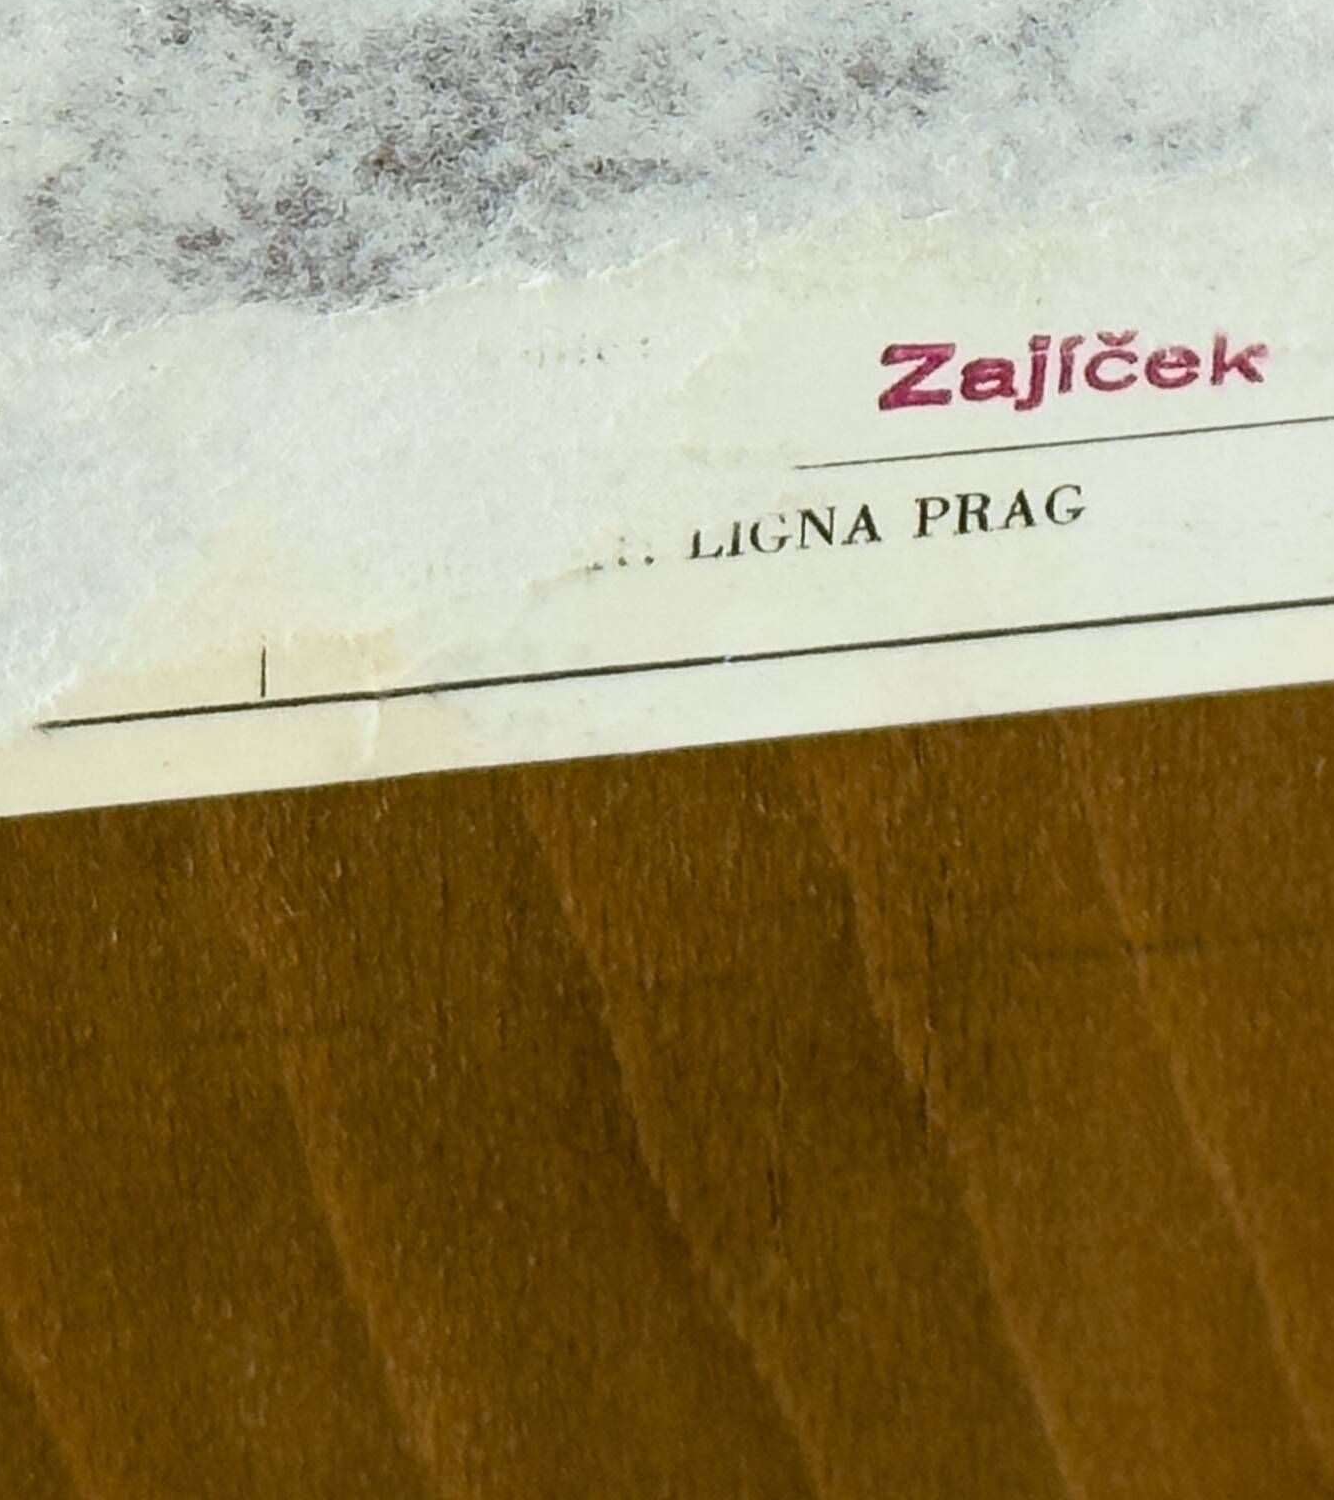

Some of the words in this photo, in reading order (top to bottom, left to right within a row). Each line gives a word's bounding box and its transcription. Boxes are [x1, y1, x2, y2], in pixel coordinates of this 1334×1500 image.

[877, 328, 1269, 413] Zajíček
[684, 502, 884, 562] LIGNA
[911, 482, 1087, 541] PRAG
